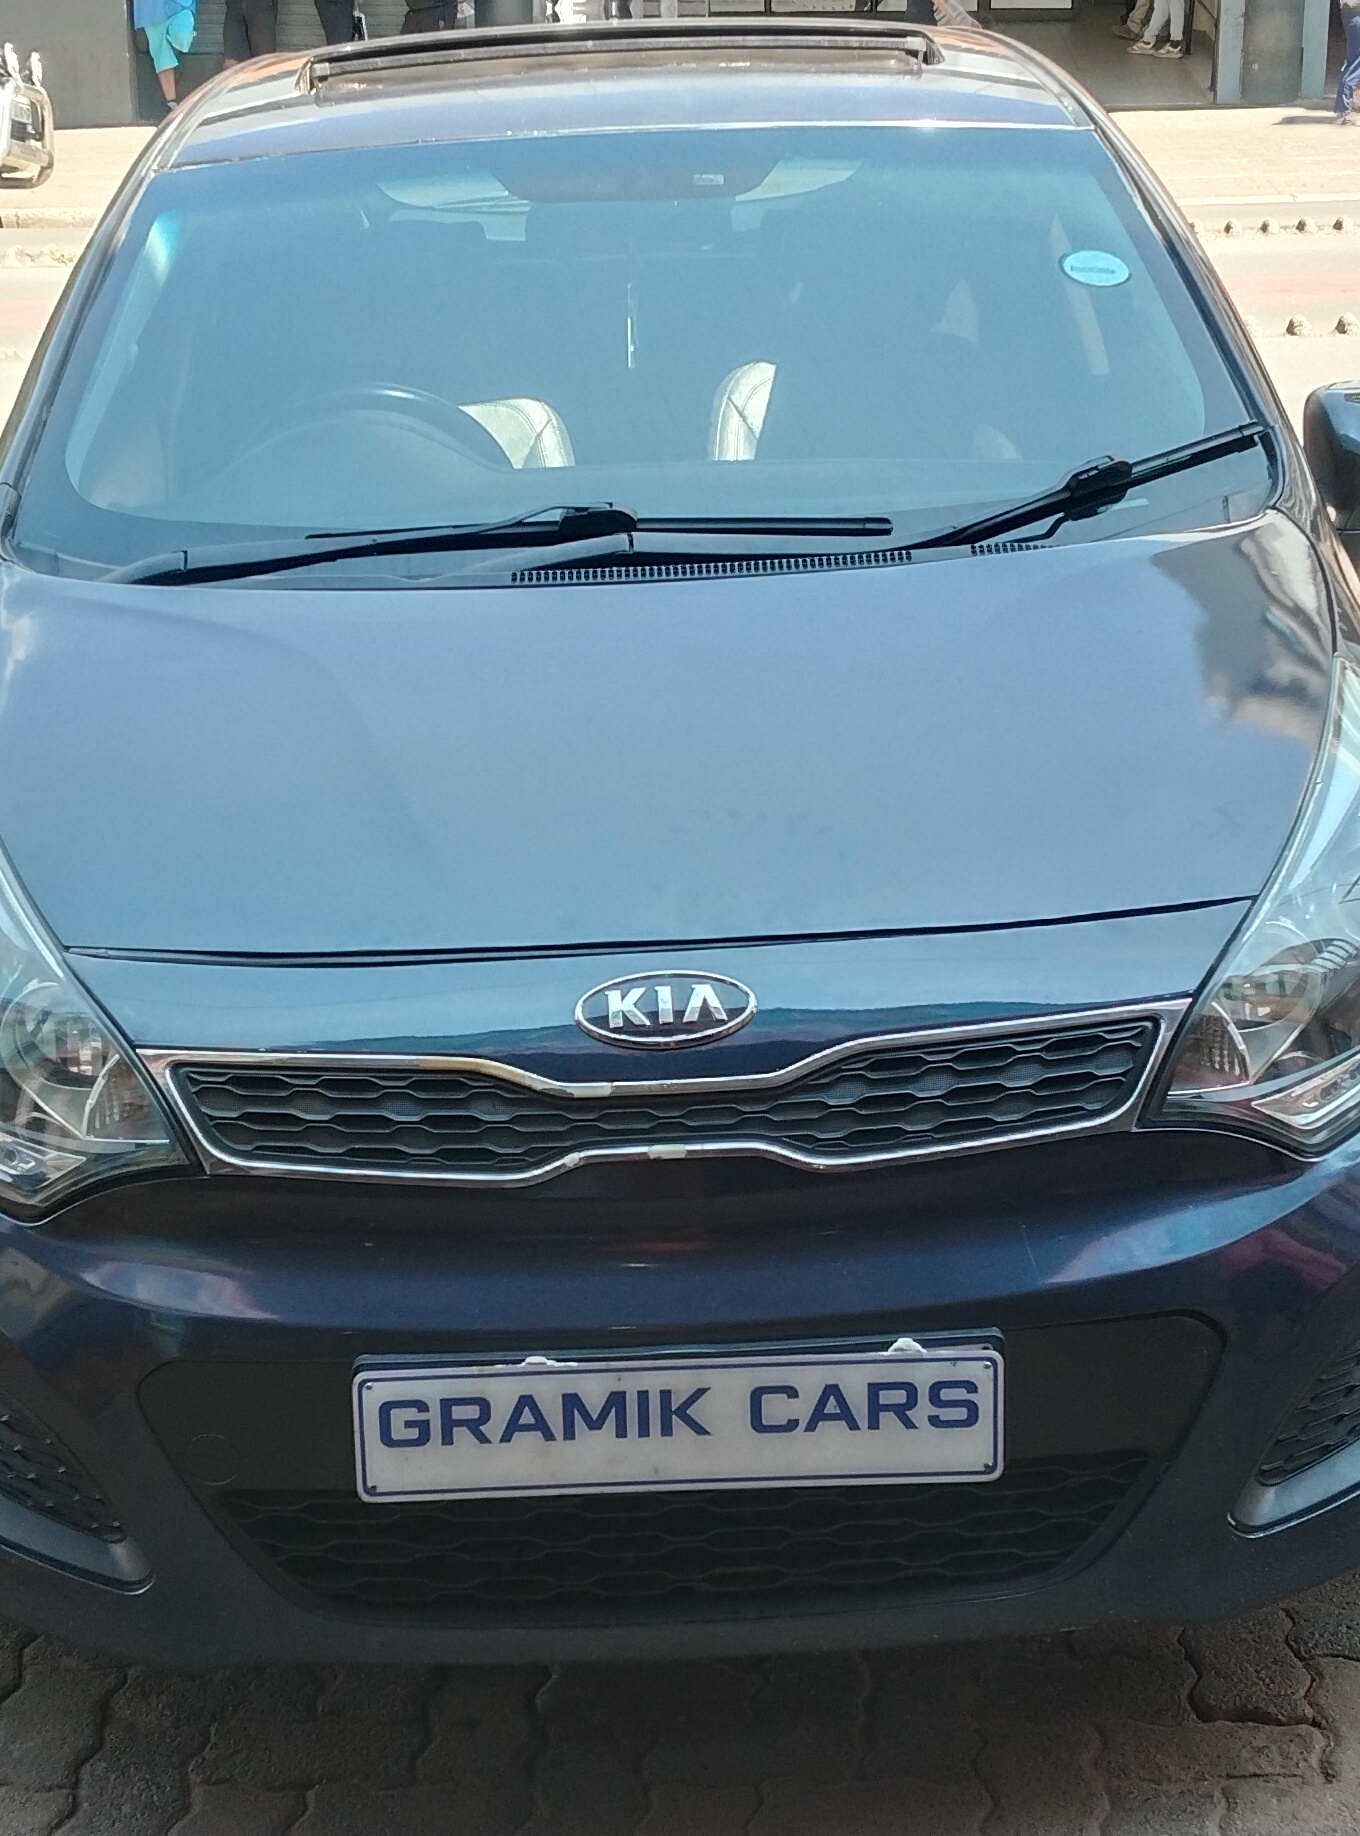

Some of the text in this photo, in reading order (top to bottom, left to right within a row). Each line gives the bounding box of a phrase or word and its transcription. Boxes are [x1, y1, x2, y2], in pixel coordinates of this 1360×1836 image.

[604, 984, 729, 1029] KIA
[377, 1378, 981, 1449] GRAMIK CARS
